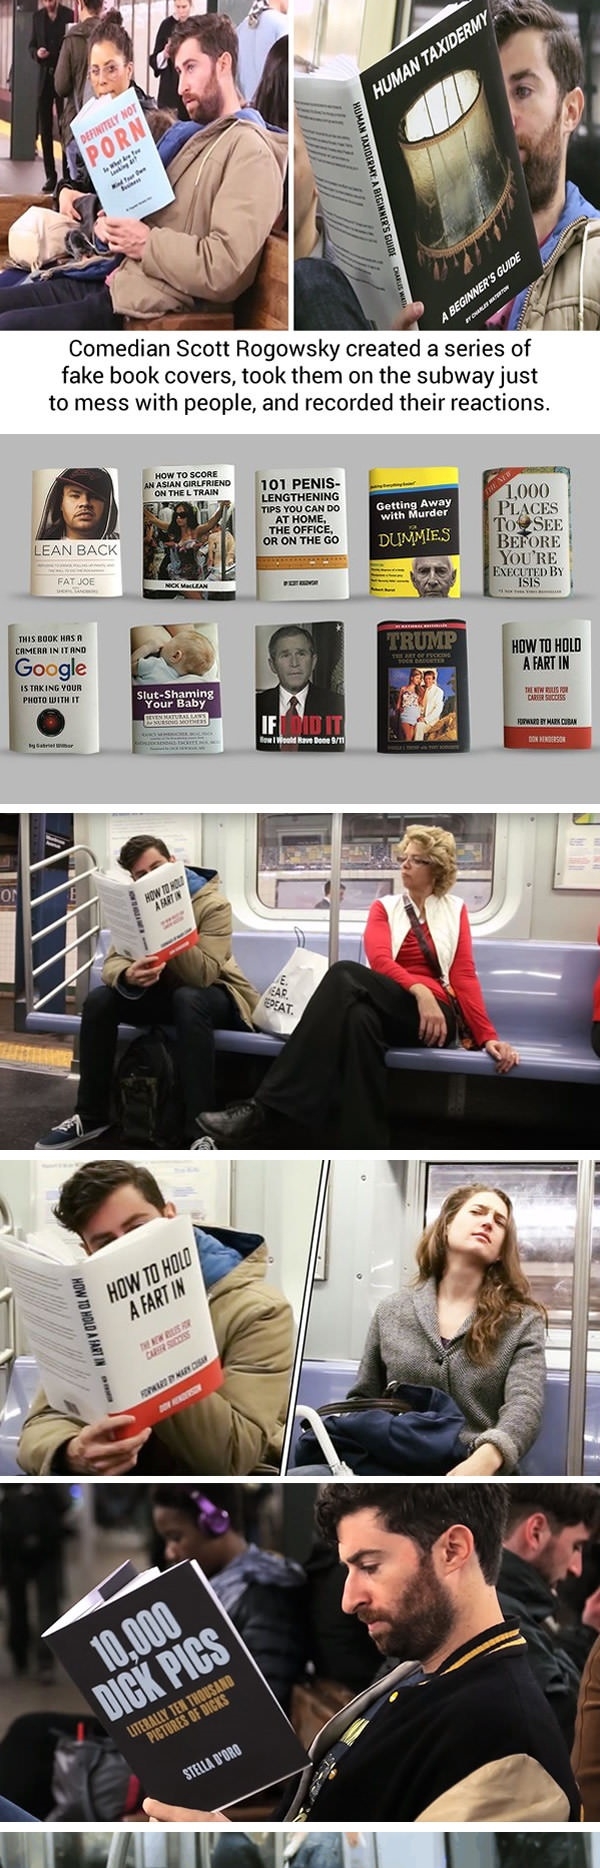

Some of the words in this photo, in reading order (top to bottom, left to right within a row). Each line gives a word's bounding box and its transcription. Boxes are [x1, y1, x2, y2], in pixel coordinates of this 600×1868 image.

[371, 56, 421, 101] HUMAN
[420, 9, 490, 67] TAXIDERMY
[506, 482, 550, 501] 1,000
[498, 500, 559, 515] PLACES
[34, 544, 72, 556] LEAN
[77, 544, 118, 556] BACK
[497, 533, 561, 549] BEFORE
[57, 578, 75, 586] FAT
[77, 577, 95, 586] JOE
[518, 577, 541, 588] ISIS
[387, 631, 458, 651] TRUMP
[262, 715, 277, 735] IF
[280, 715, 286, 735] I
[296, 715, 322, 735] DID
[325, 715, 343, 735] IT
[106, 1271, 141, 1304] HOW
[142, 1263, 160, 1284] TO
[161, 1247, 192, 1278] HOLD
[130, 1300, 140, 1321] A
[141, 1284, 169, 1315] FART
[171, 1277, 186, 1300] IN
[89, 1601, 183, 1673] 10,000
[91, 1661, 167, 1722] DICK
[155, 1627, 231, 1690] PICS
[182, 1757, 216, 1781] STELLA
[212, 1743, 243, 1766] D'ORO
